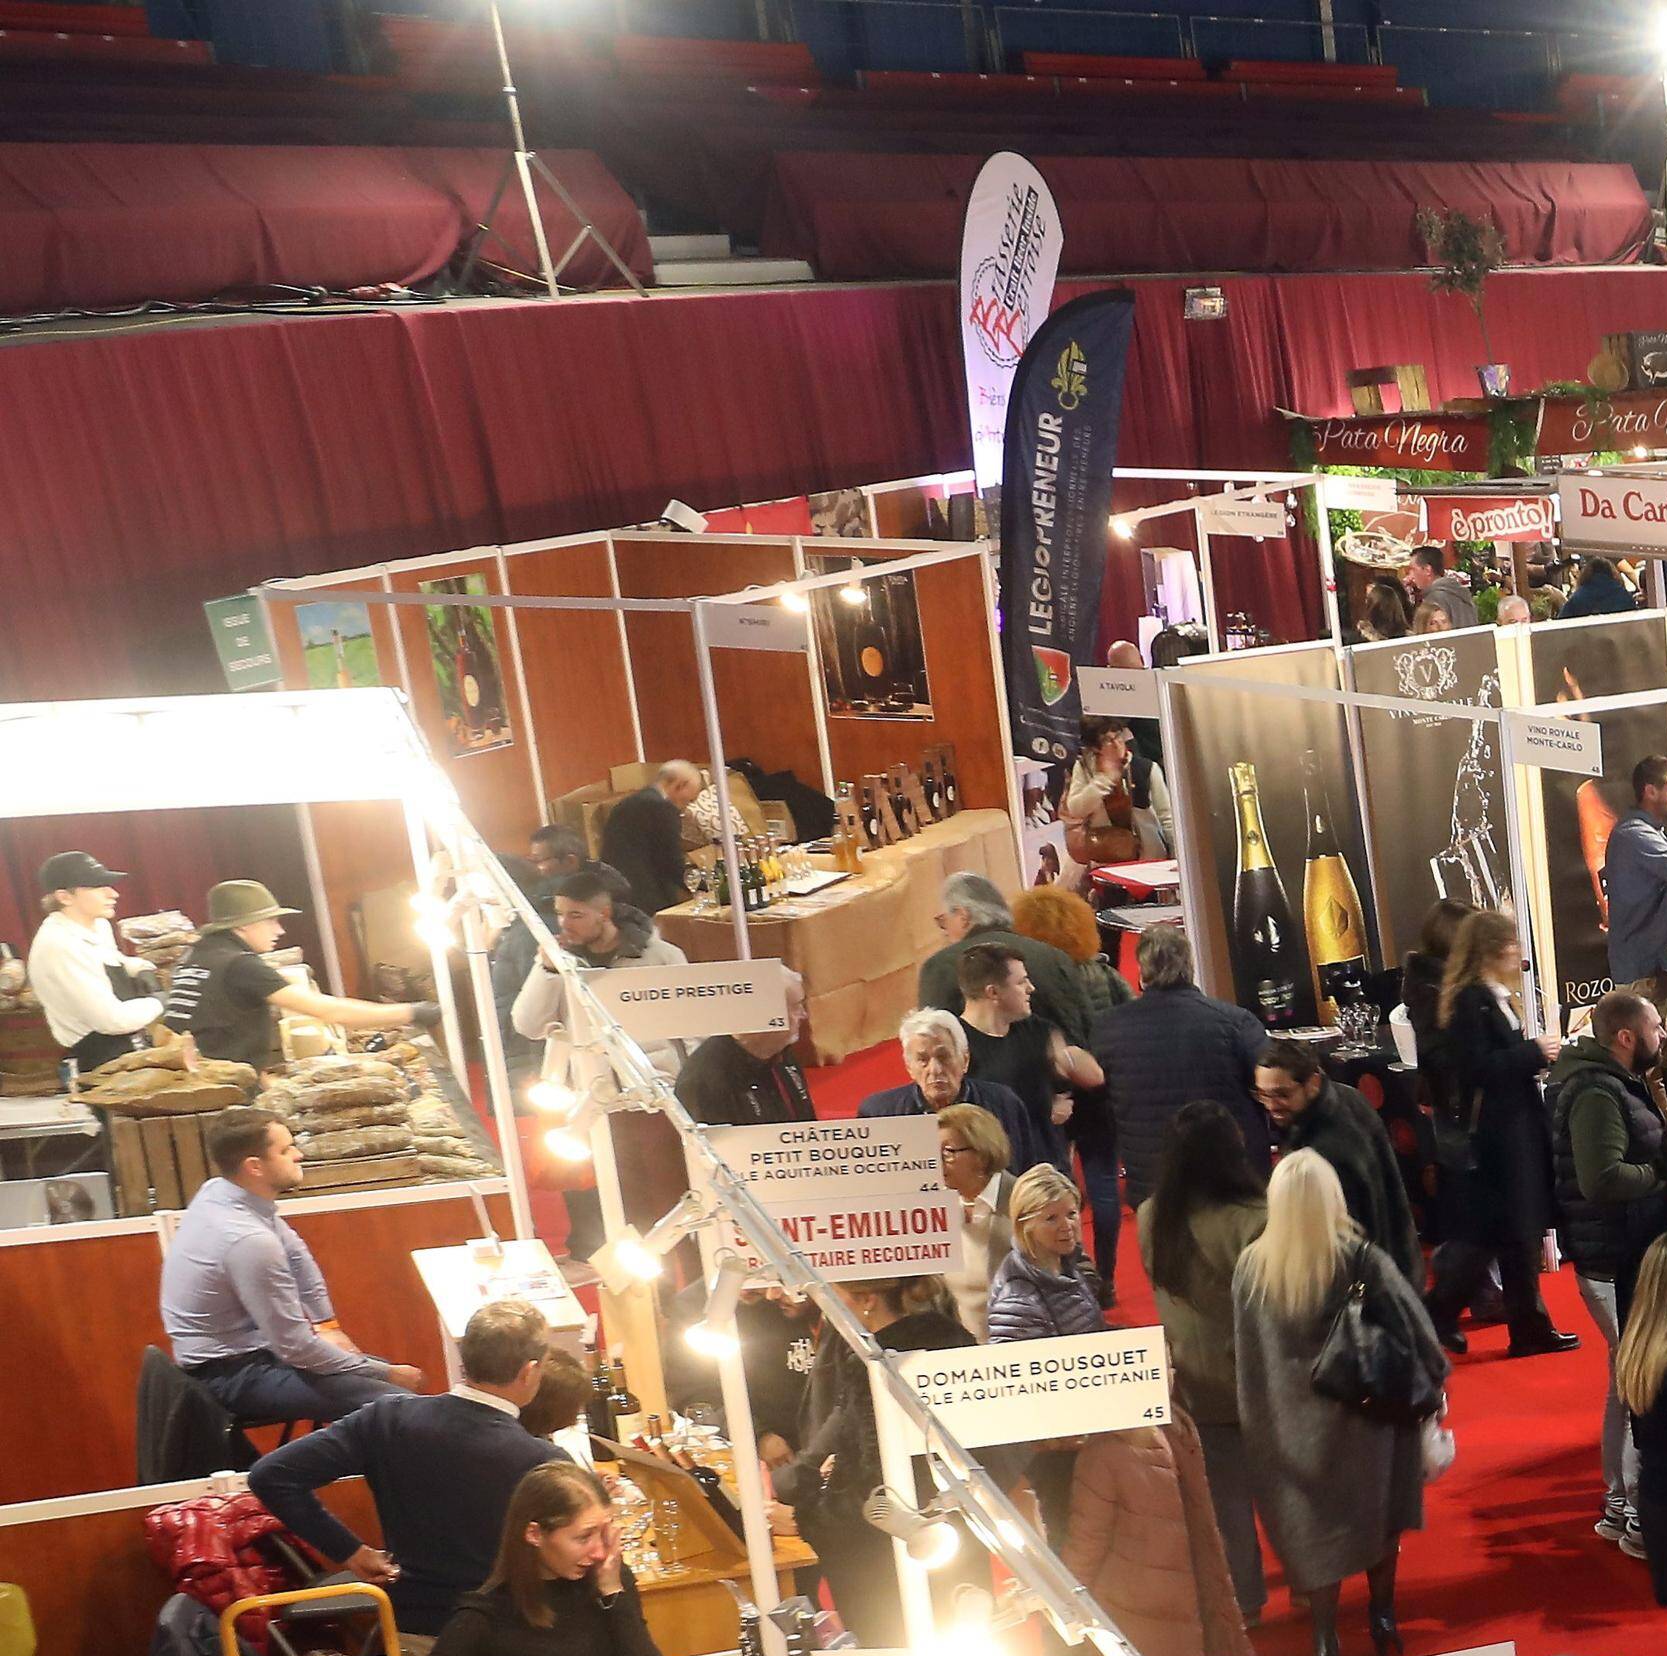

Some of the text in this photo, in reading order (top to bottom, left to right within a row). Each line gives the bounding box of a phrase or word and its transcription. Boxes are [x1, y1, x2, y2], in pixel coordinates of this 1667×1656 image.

[1571, 400, 1651, 442] Pata
[1313, 418, 1469, 463] Pata Negra
[1579, 488, 1616, 519] Da
[1470, 498, 1554, 541] pronto!
[1528, 725, 1580, 740] VINO ROYALE
[1526, 736, 1583, 752] MONTE-CARLO
[620, 983, 753, 1002] GUIDE PRESTIGE
[769, 1018, 785, 1027] 43
[780, 1126, 871, 1145] CHÂTEAU
[751, 1144, 902, 1165] PETIT BOUQUEY
[765, 1165, 849, 1179] AQUITAINE
[854, 1159, 937, 1174] OCCITANIE
[863, 1243, 951, 1264] RECOLTANT
[916, 1349, 1148, 1389] DOMAINE BOUSQUET
[960, 1380, 1059, 1402] AQUITAINE
[1065, 1368, 1161, 1391] OCCITANIE
[1143, 1406, 1165, 1419] 45
